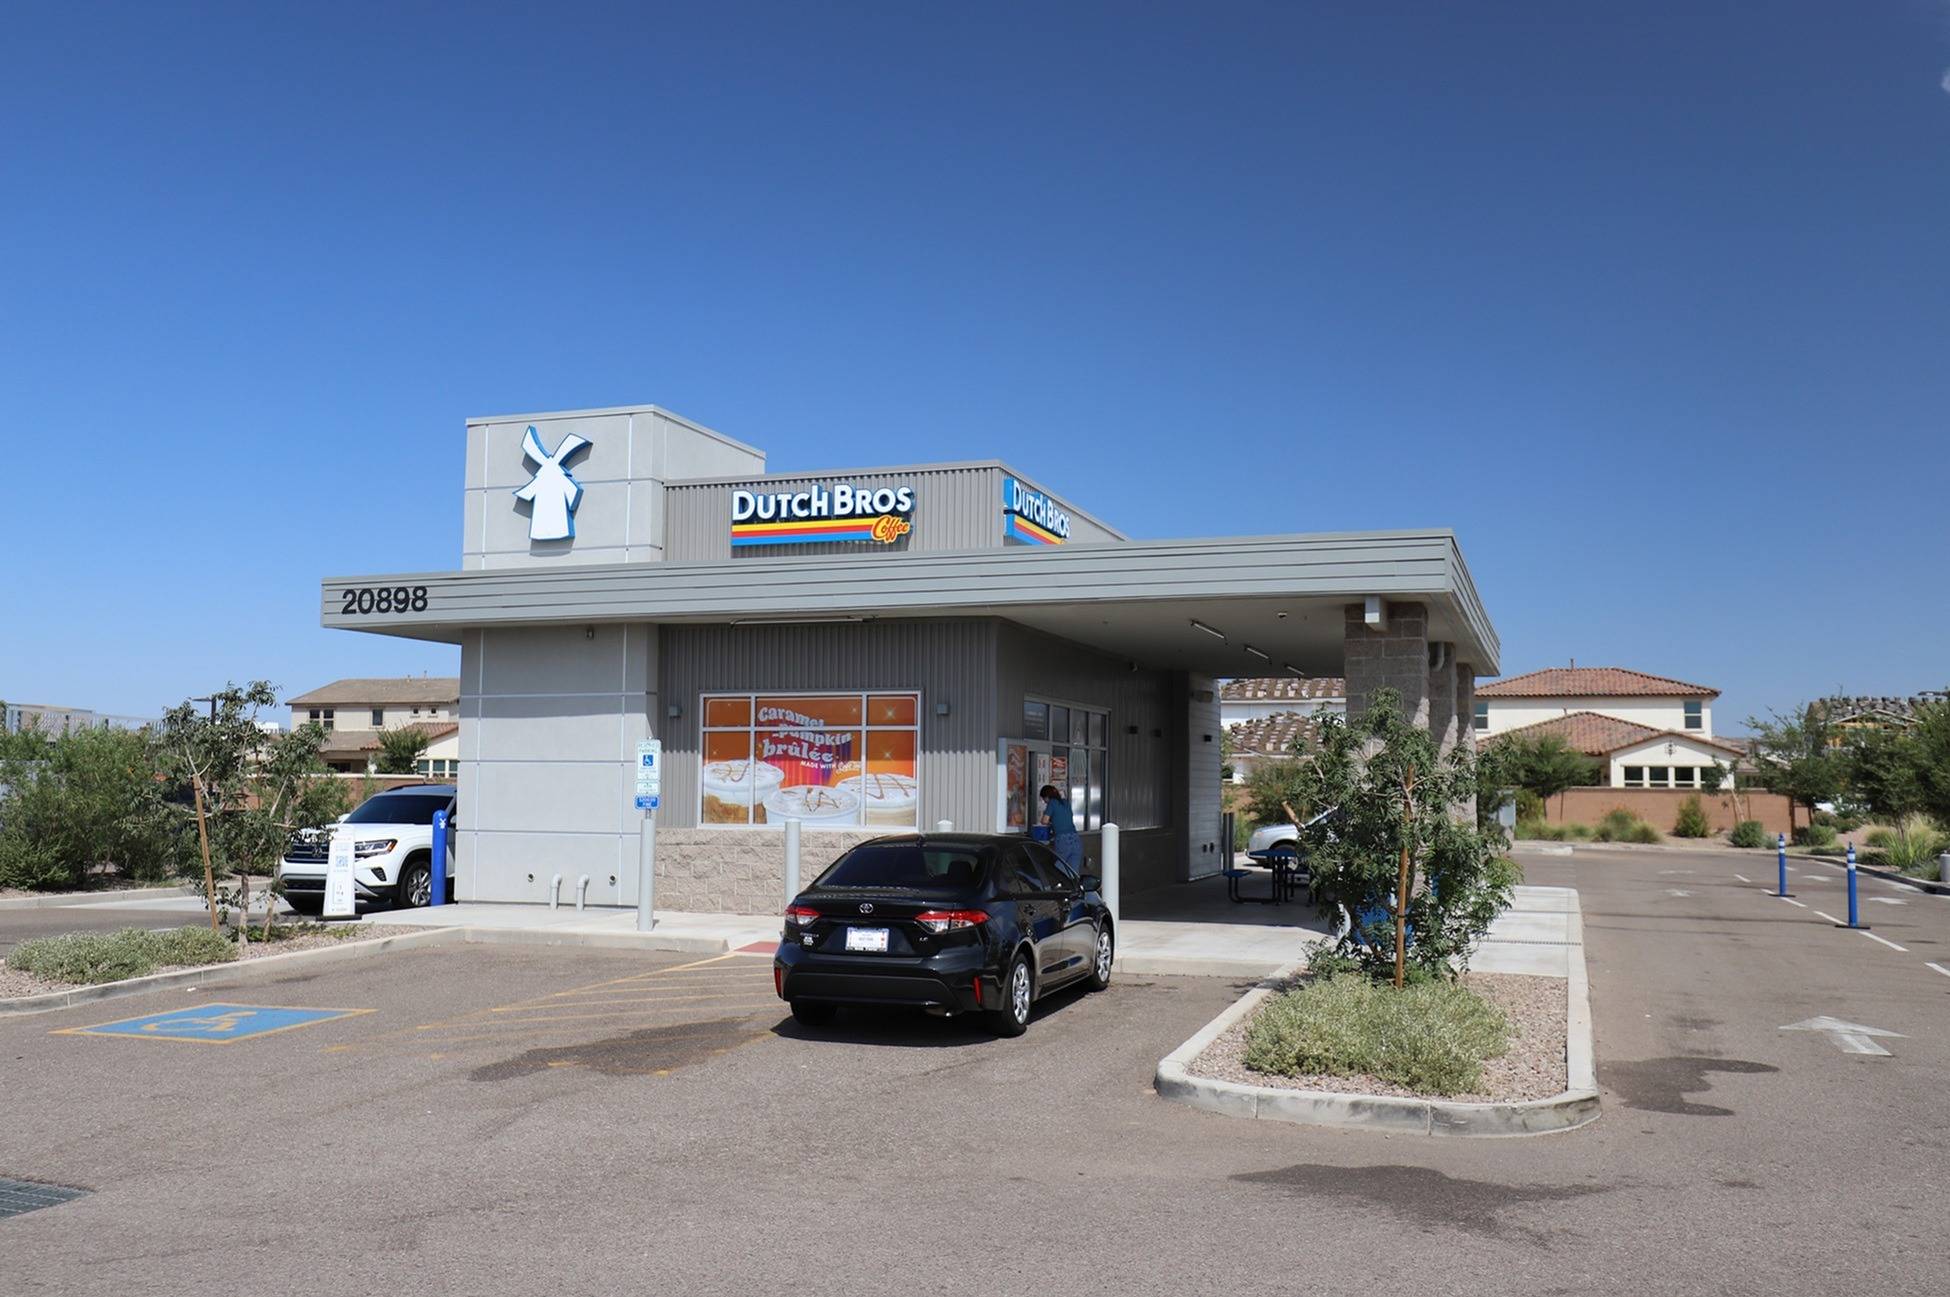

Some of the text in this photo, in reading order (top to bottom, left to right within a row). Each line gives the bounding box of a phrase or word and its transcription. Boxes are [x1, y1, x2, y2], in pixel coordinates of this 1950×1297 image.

[834, 484, 914, 515] BROS
[872, 515, 910, 543] Coffee
[1047, 499, 1070, 538] BROS
[341, 585, 428, 615] 20898
